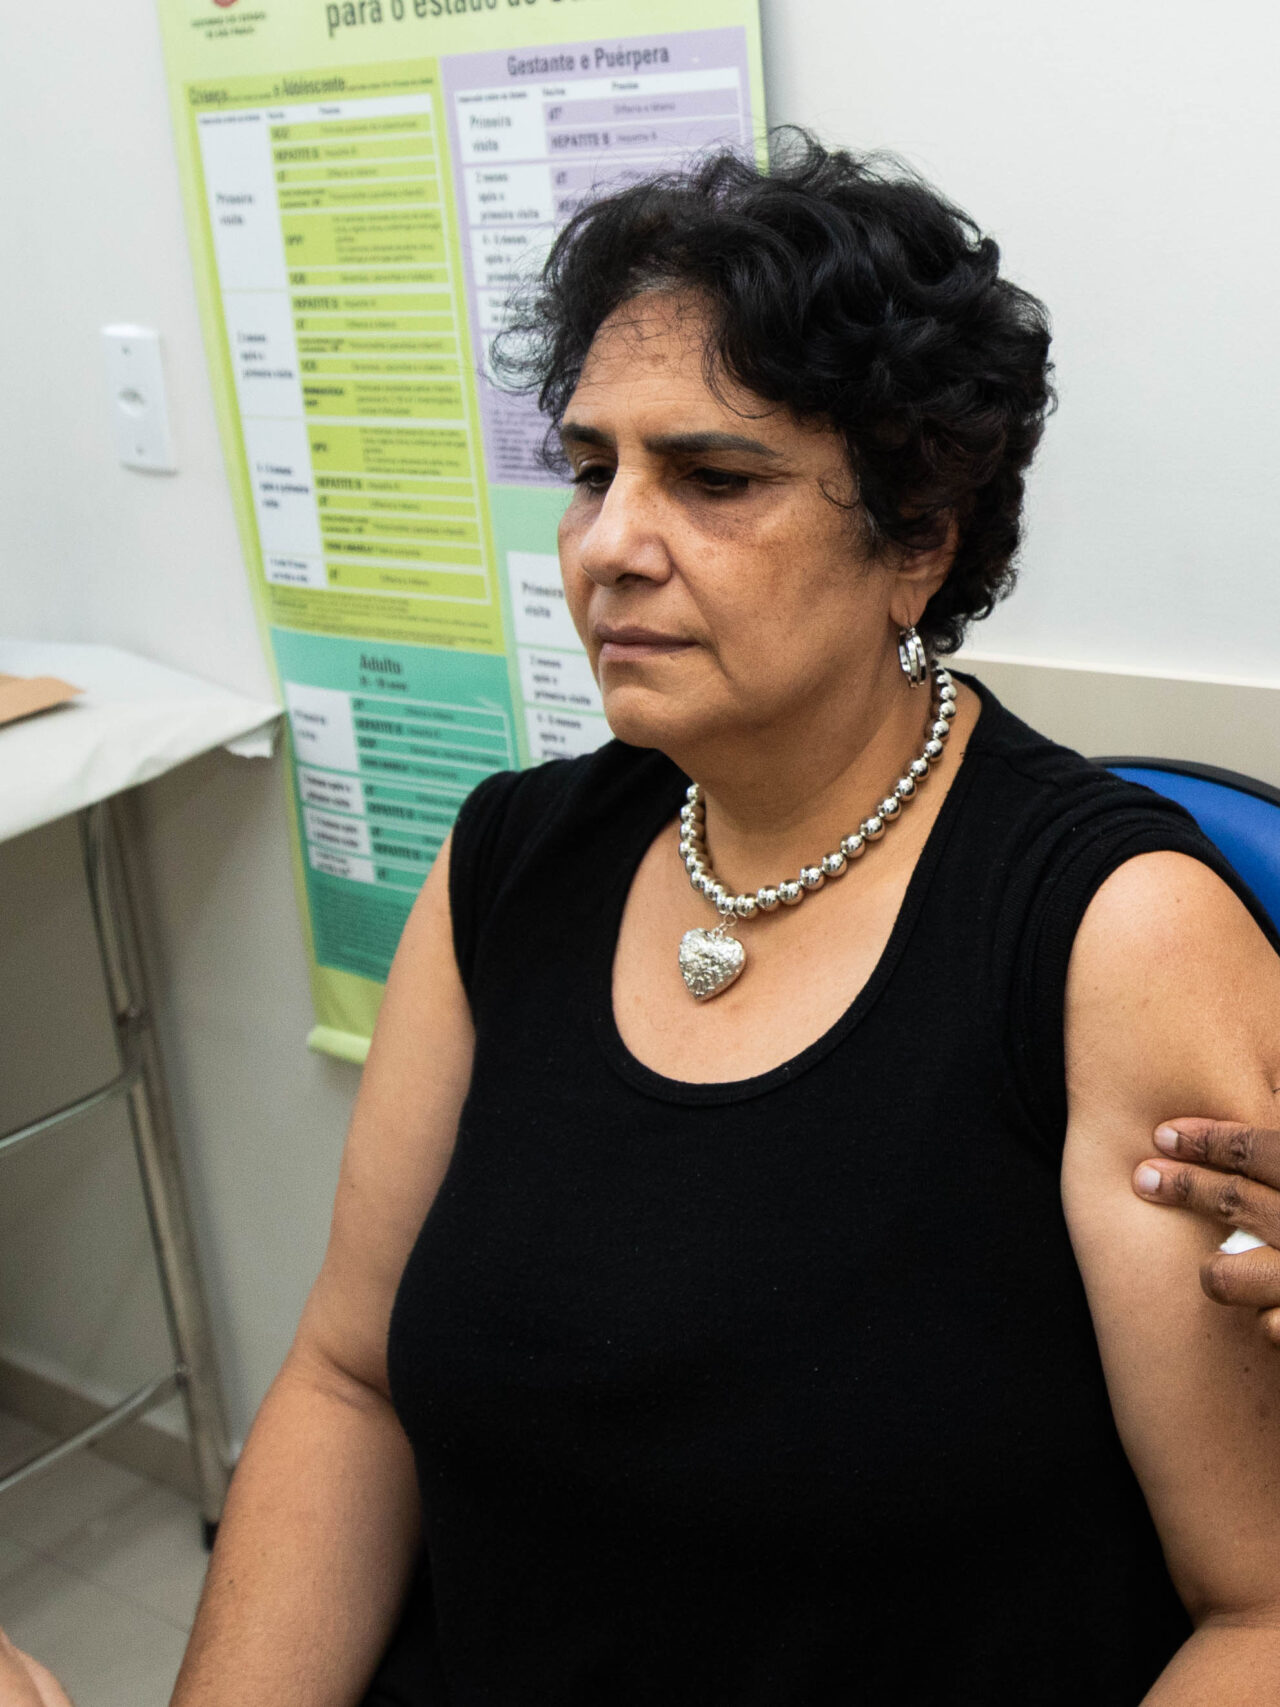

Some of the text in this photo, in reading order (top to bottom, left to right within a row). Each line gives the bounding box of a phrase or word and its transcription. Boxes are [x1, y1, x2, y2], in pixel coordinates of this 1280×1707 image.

[325, 0, 383, 37] para
[506, 45, 671, 76] Gestante e Puérpera
